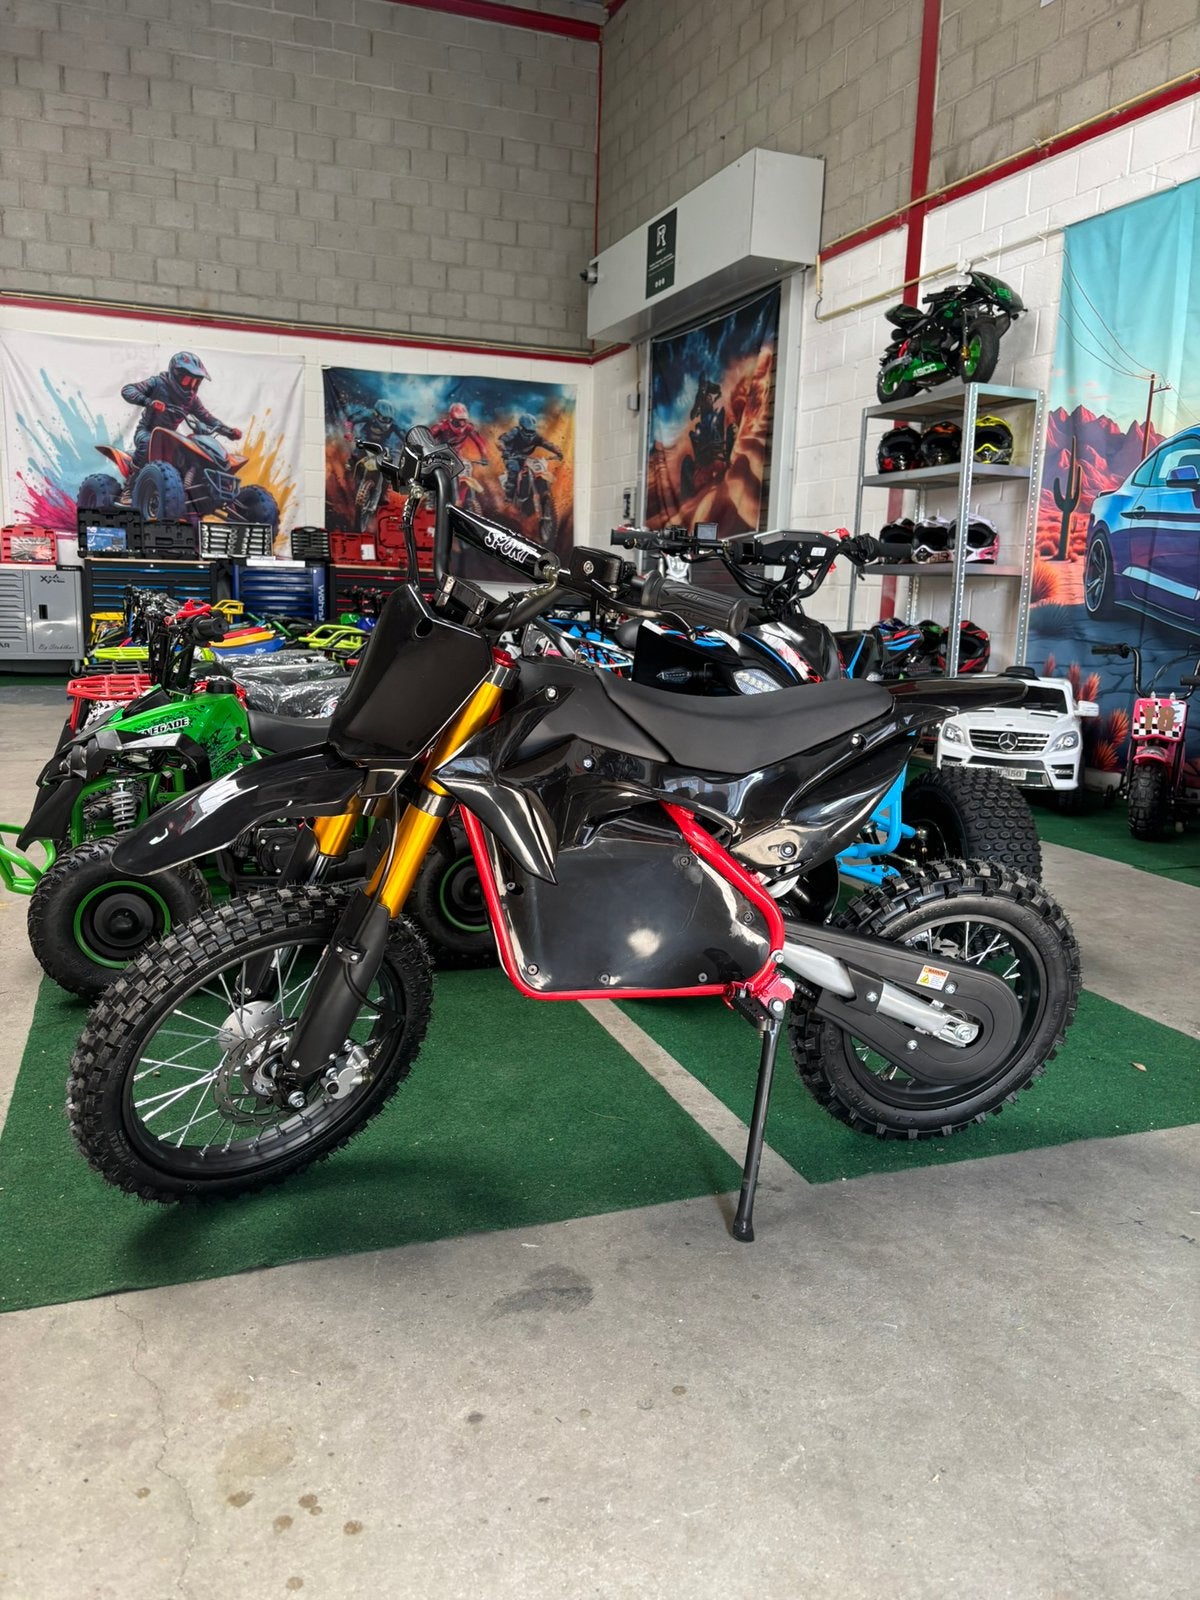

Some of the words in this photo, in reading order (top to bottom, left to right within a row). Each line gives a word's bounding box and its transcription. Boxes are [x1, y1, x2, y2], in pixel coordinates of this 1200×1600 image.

[484, 531, 529, 563] SPORT
[137, 717, 189, 736] NEGADE
[1142, 706, 1176, 731] 18
